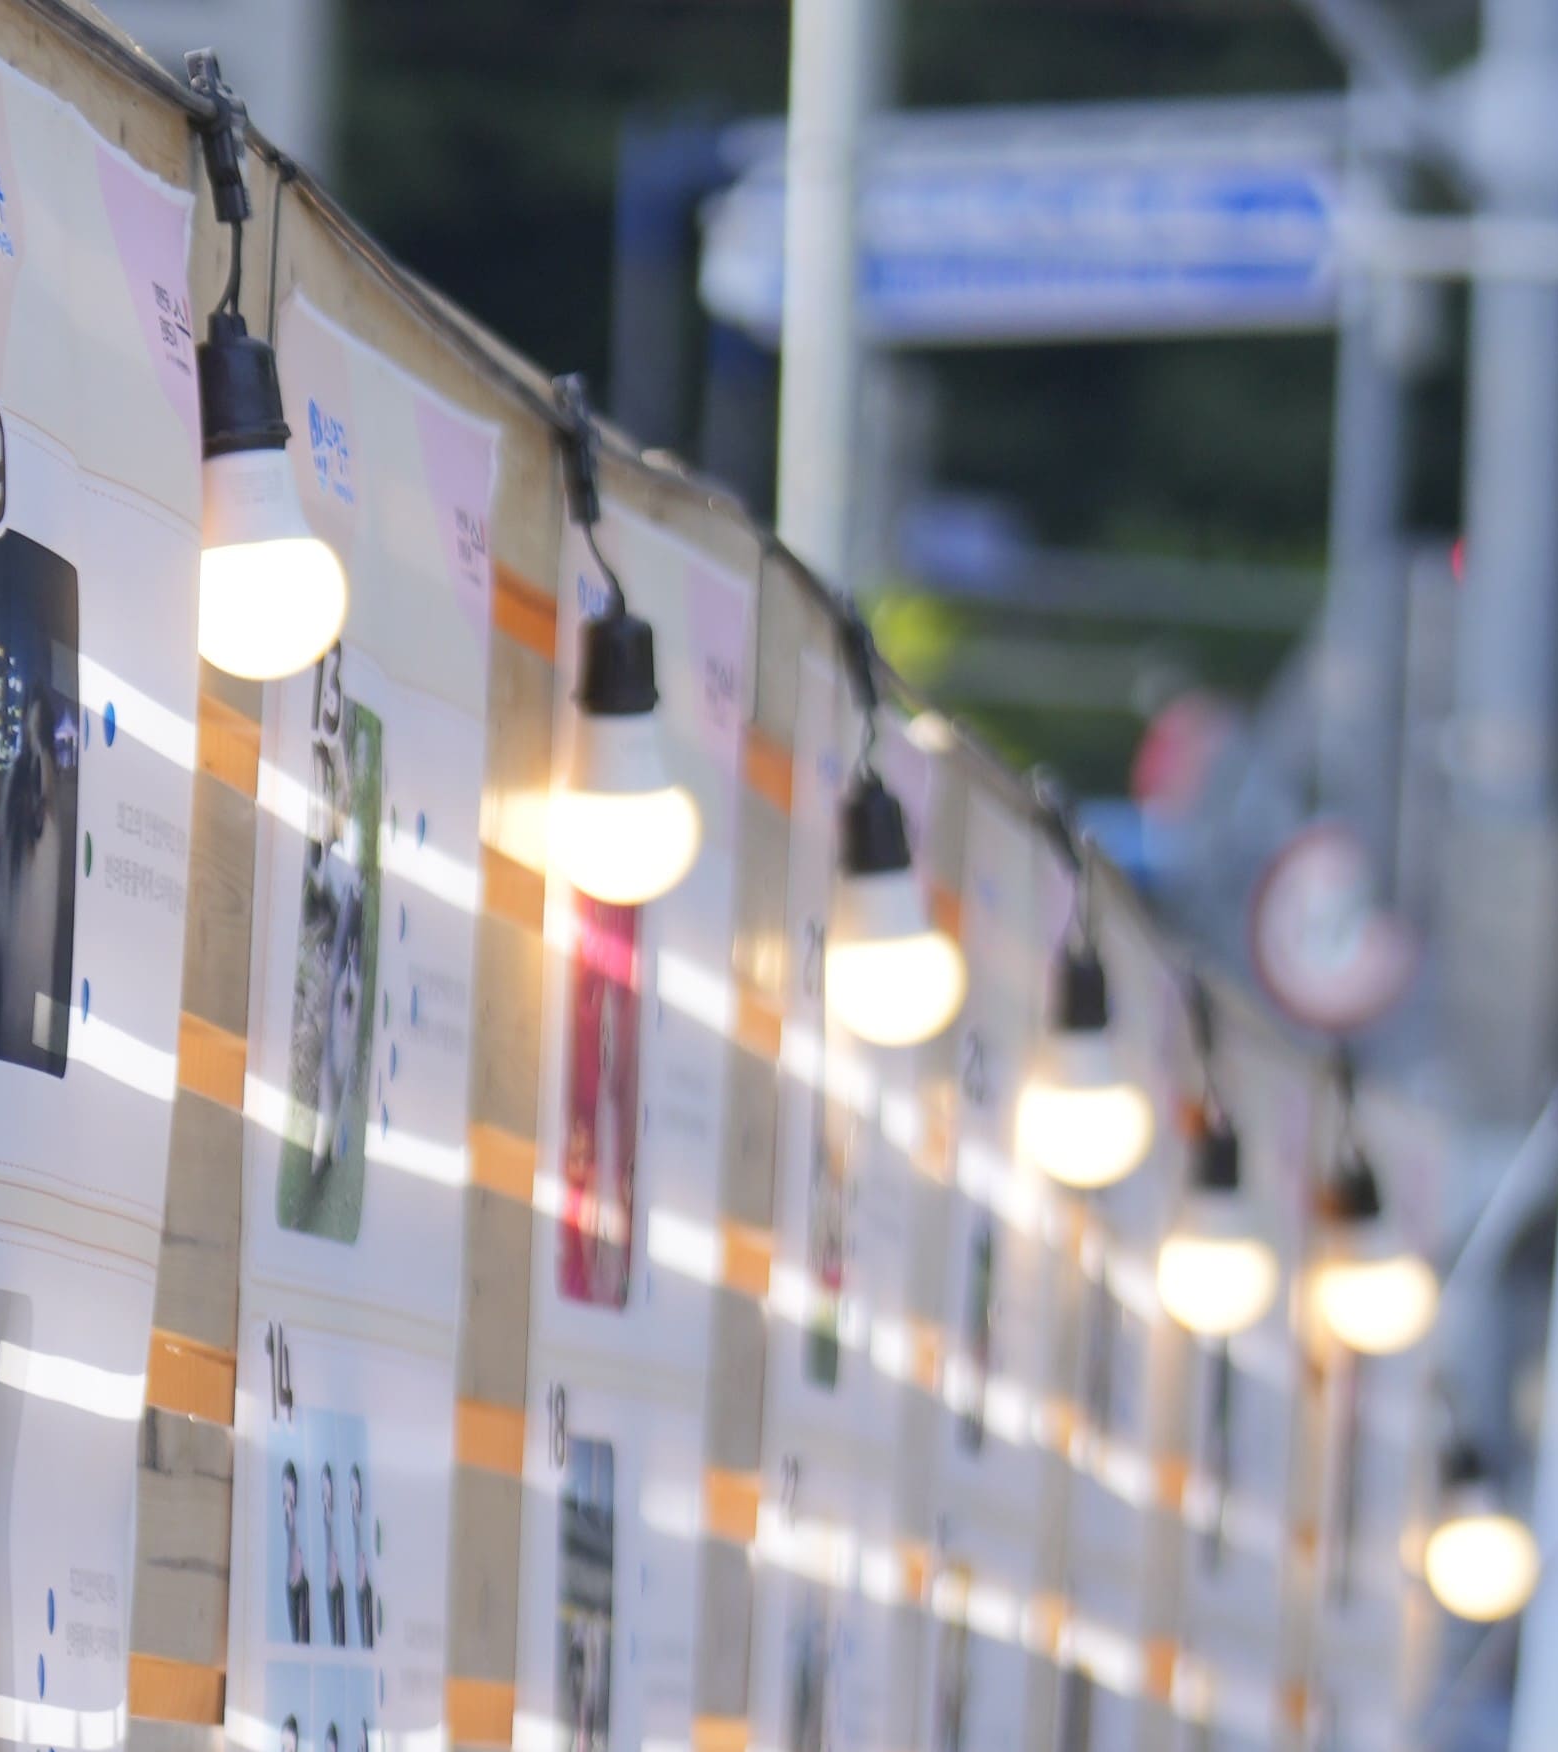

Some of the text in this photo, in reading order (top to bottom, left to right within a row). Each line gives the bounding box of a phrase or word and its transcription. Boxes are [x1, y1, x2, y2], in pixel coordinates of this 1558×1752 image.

[311, 638, 341, 736] 13
[265, 1321, 293, 1421] 14
[546, 1382, 566, 1470] 18
